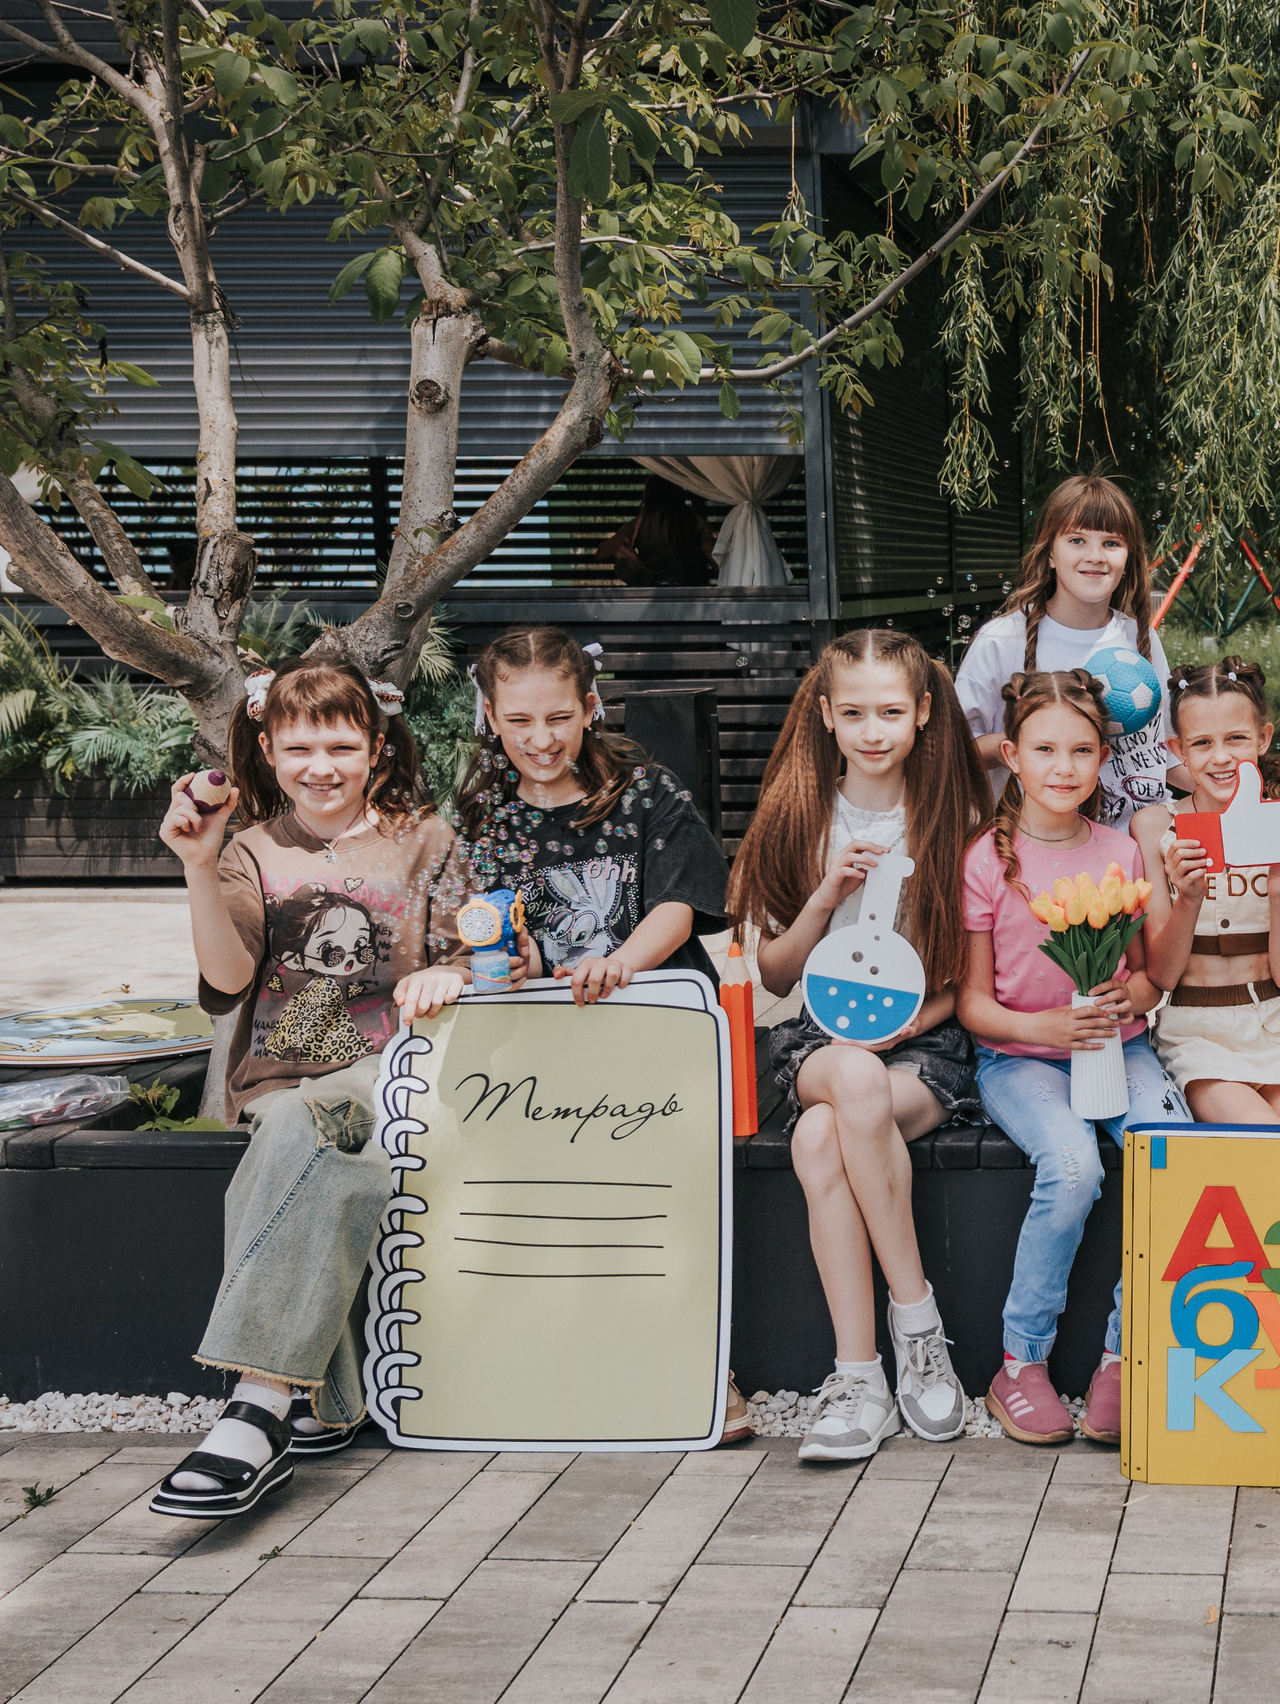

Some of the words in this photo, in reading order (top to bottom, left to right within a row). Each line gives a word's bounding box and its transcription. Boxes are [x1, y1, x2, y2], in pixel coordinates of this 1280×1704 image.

[1110, 731, 1147, 756] MIND
[1108, 757, 1127, 778] TO
[1130, 746, 1166, 771] NEW
[454, 1072, 684, 1144] Тетрадь
